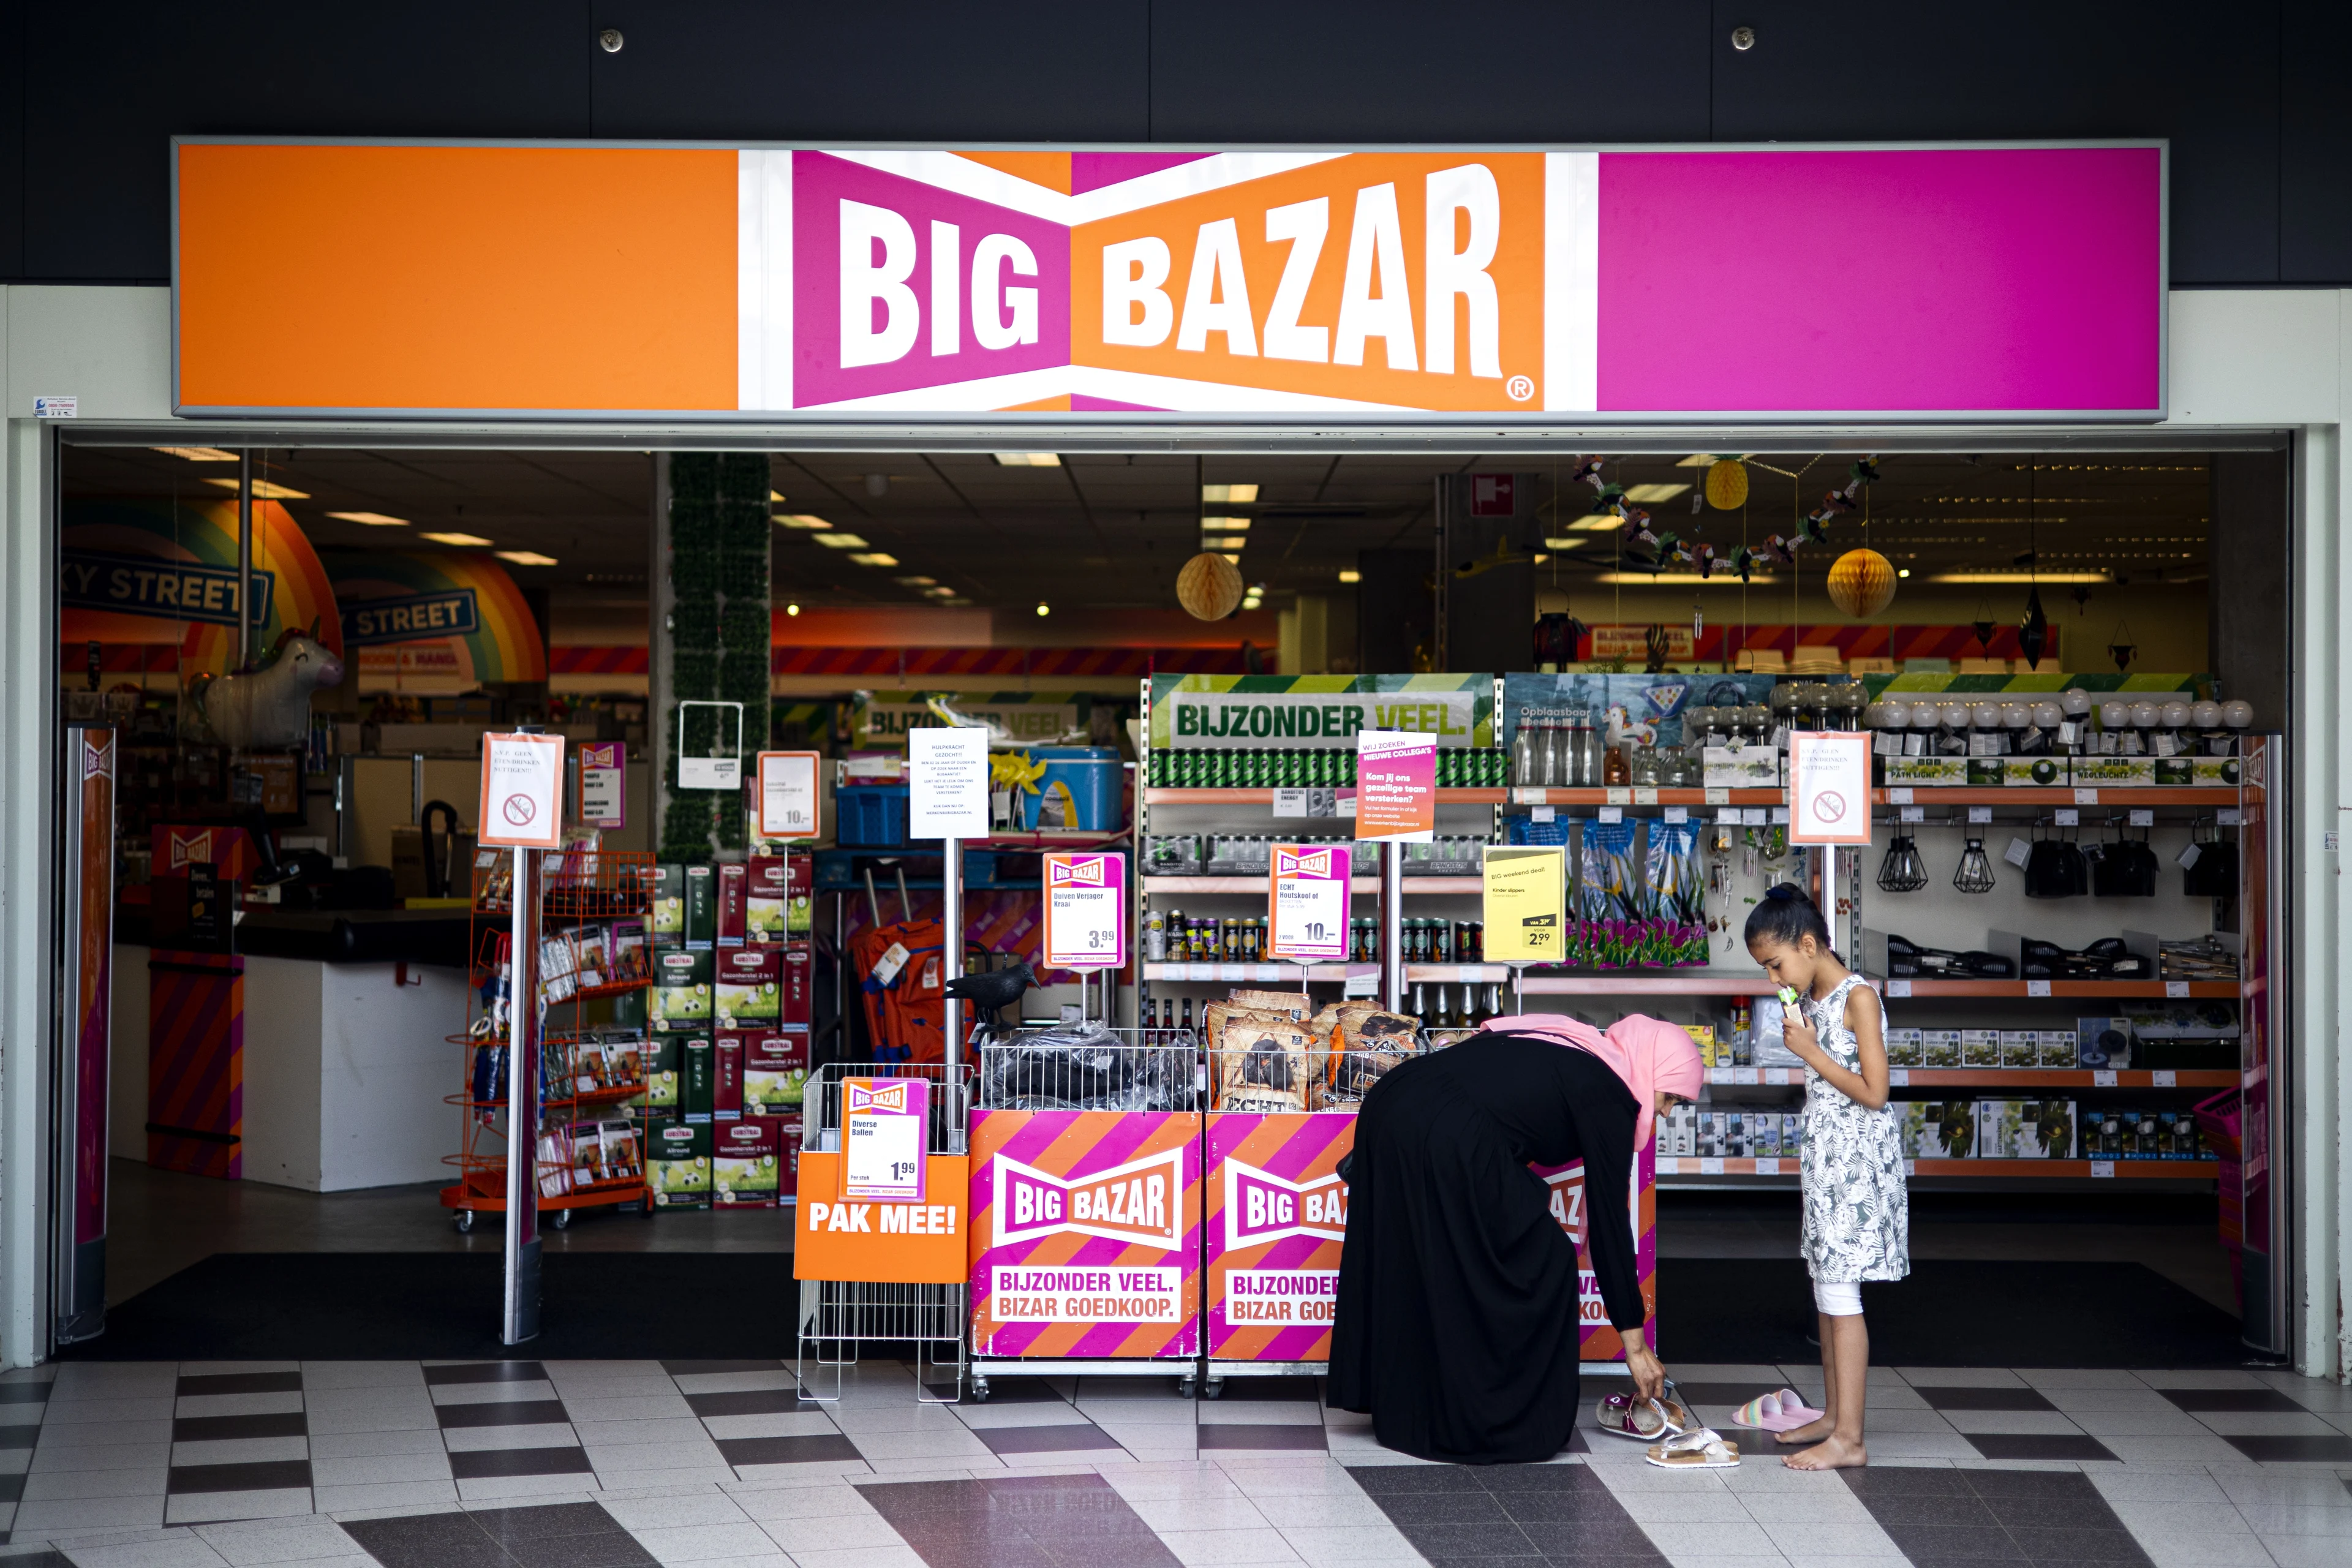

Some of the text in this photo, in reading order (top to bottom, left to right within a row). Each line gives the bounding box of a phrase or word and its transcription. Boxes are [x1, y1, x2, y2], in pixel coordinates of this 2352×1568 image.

[840, 164, 1503, 378] BIG BAZAR
[109, 570, 239, 612] STREET
[357, 600, 461, 635] STREET
[1177, 703, 1467, 737] BIJZONDER VEEL.
[1521, 706, 1591, 717] Opblaasbaar
[1363, 747, 1432, 761] NIEUWE COLLEGA'S
[1378, 740, 1406, 750] ZOEKEN
[88, 752, 98, 771] BIG
[1385, 773, 1394, 783] jij
[1365, 783, 1403, 793] gezellige
[1056, 864, 1099, 880] BIG BAZAR
[1283, 856, 1325, 872] BIG BAZAR
[1502, 869, 1529, 878] weekend
[1088, 930, 1115, 948] 3.99
[1529, 933, 1550, 946] 2.99
[855, 1090, 901, 1107] BIG BAZAR
[891, 1162, 915, 1181] 1.99
[1015, 1174, 1165, 1228] BIG BAZAR
[1247, 1185, 1293, 1228] BIG
[809, 1202, 956, 1235] PAK MEE!
[1000, 1273, 1173, 1292] BIJZONDER VEEL.
[999, 1297, 1173, 1317] BIZAR GOEDKOOP.
[1234, 1301, 1292, 1320] BIZAR
